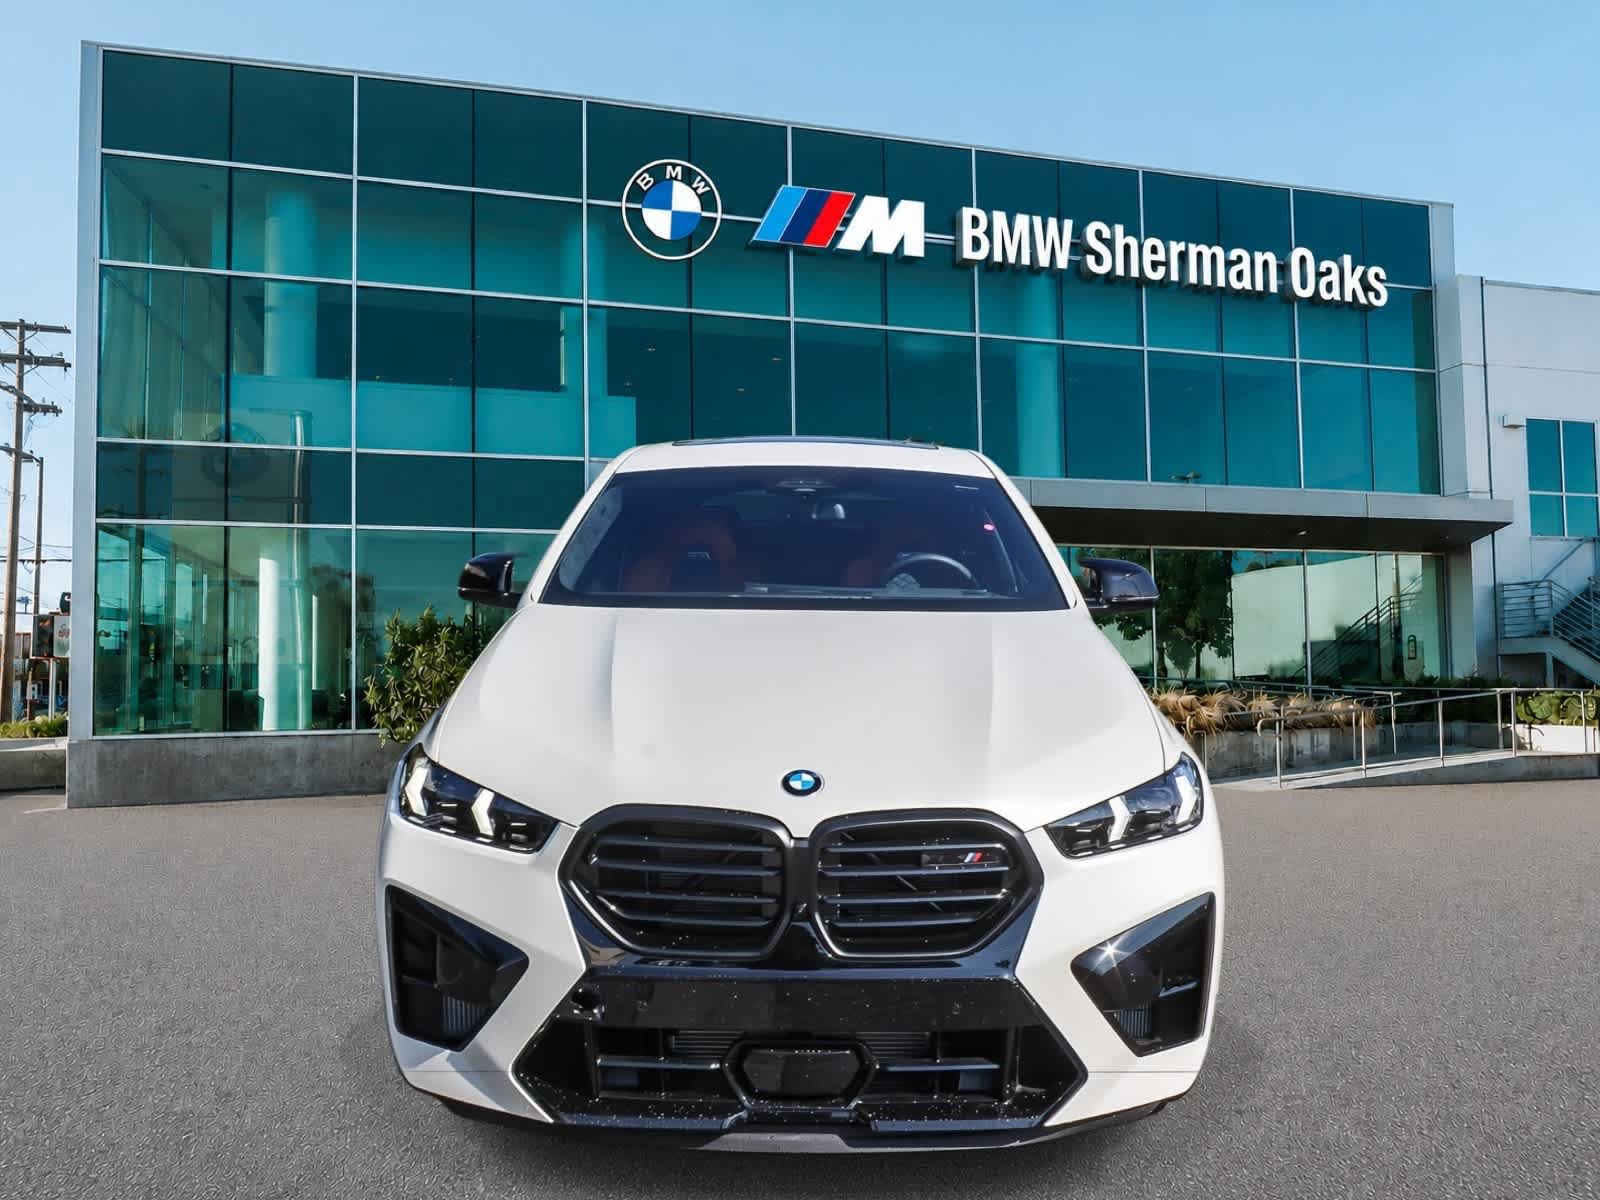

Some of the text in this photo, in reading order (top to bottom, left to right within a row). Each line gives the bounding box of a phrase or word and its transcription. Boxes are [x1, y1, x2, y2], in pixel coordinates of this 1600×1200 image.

[636, 165, 711, 195] BMW
[836, 195, 925, 258] M
[960, 206, 1389, 308] BMW Sherman Oaks
